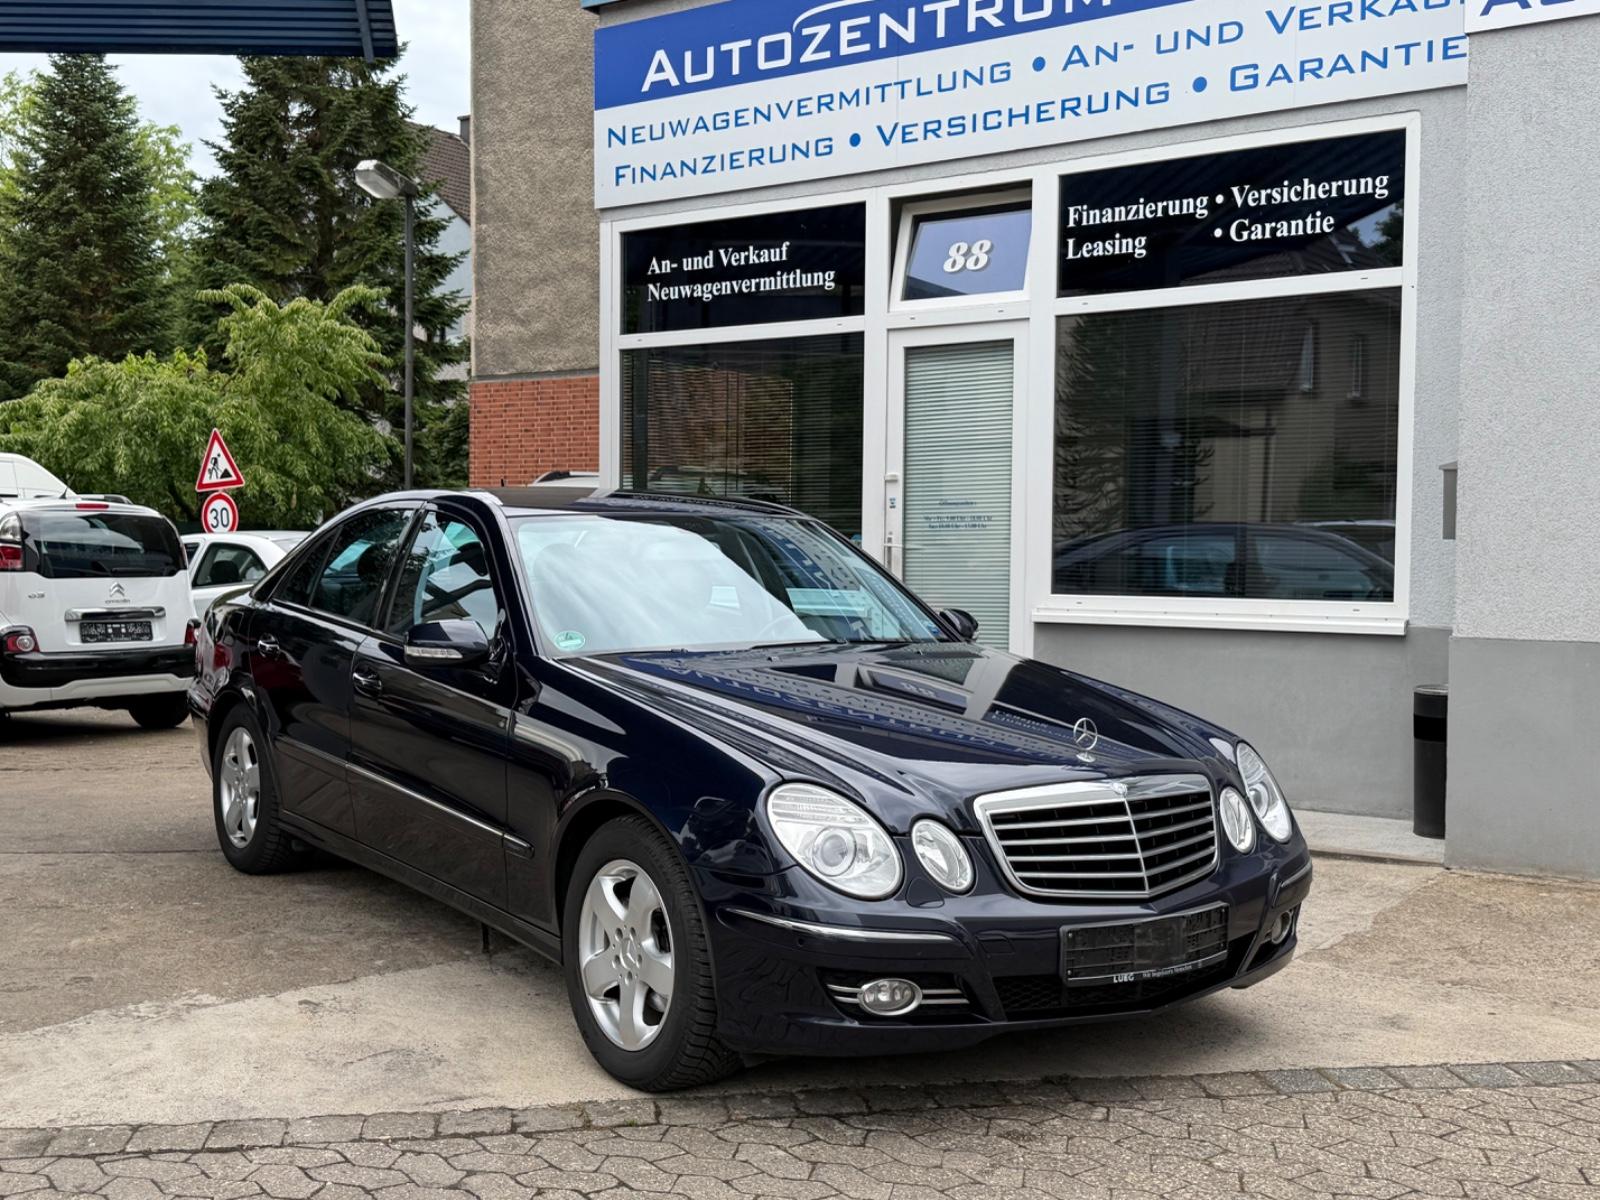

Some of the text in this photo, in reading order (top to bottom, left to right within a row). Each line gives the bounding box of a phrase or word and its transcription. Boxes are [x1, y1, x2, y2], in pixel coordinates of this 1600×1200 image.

[607, 61, 1012, 148] NEUWAGENVERMITTLUNG
[1062, 43, 1135, 71] AN-
[1155, 20, 1244, 55] UND
[1265, 0, 1465, 34] VERKA
[615, 34, 1467, 186] FINANZIERUNG VERSICHERUNG GARANTIE
[1067, 174, 1389, 228] Finanzierung Versicherung
[1229, 210, 1335, 242] Garantie
[647, 241, 790, 276] An- und Verkauf
[943, 239, 992, 273] 88
[1066, 232, 1147, 260] Leasing
[647, 268, 836, 302] Neuwagenvermittlung
[210, 507, 230, 529] 30
